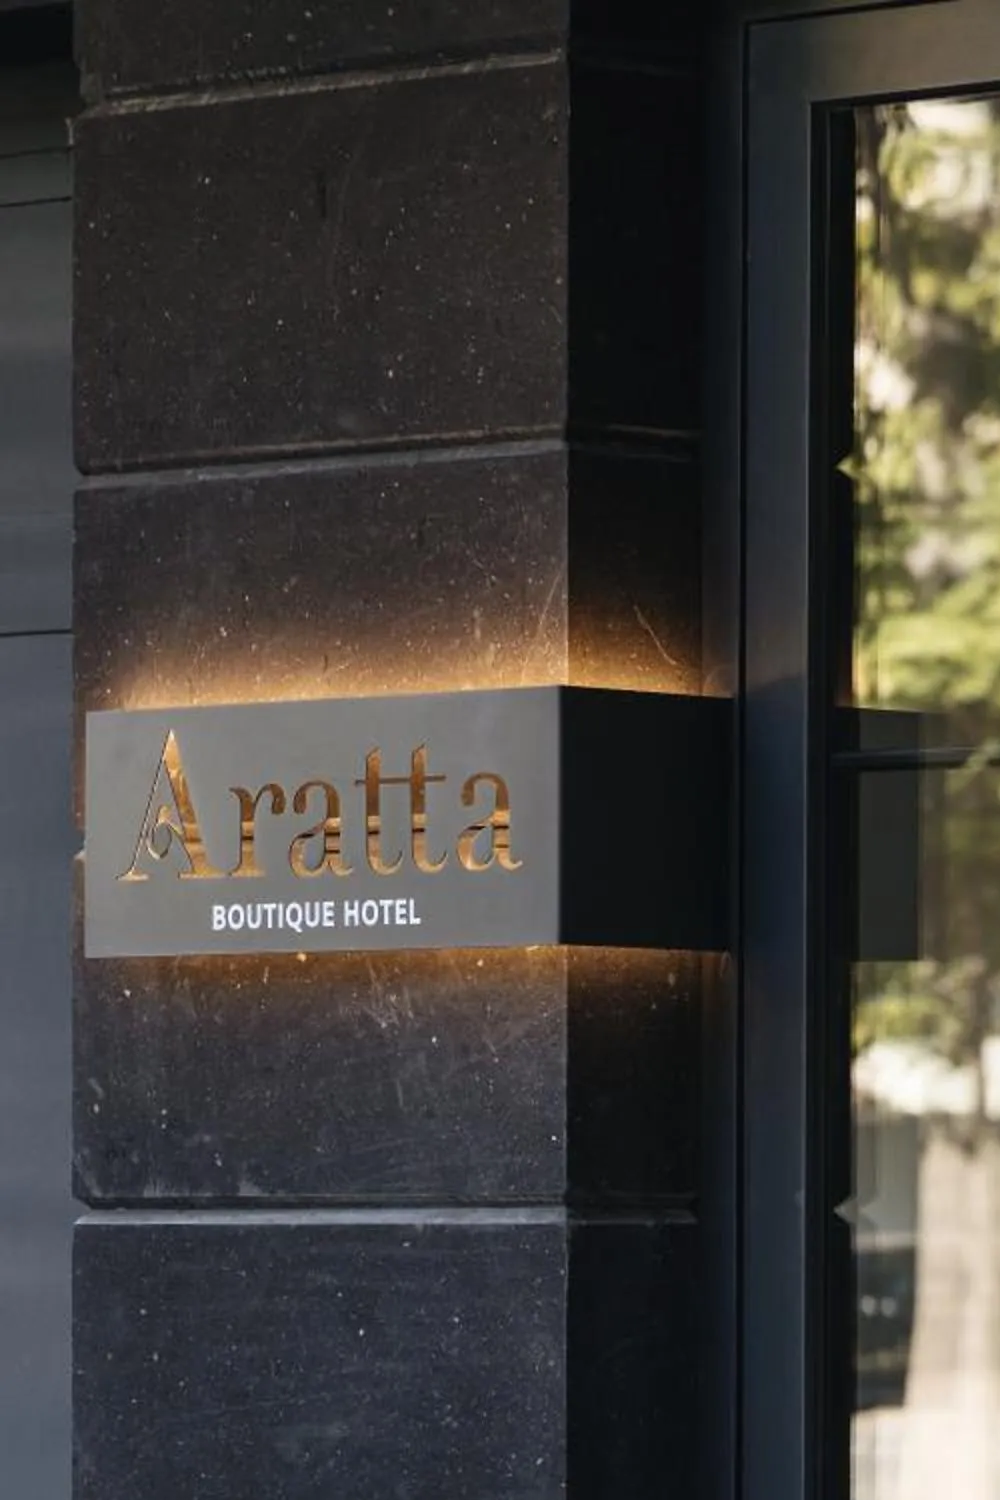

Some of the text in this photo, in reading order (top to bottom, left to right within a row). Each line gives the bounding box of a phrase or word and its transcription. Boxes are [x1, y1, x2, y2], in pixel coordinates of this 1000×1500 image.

[115, 728, 524, 882] Aratta
[212, 898, 421, 932] BOUTIQUE HOTEL
